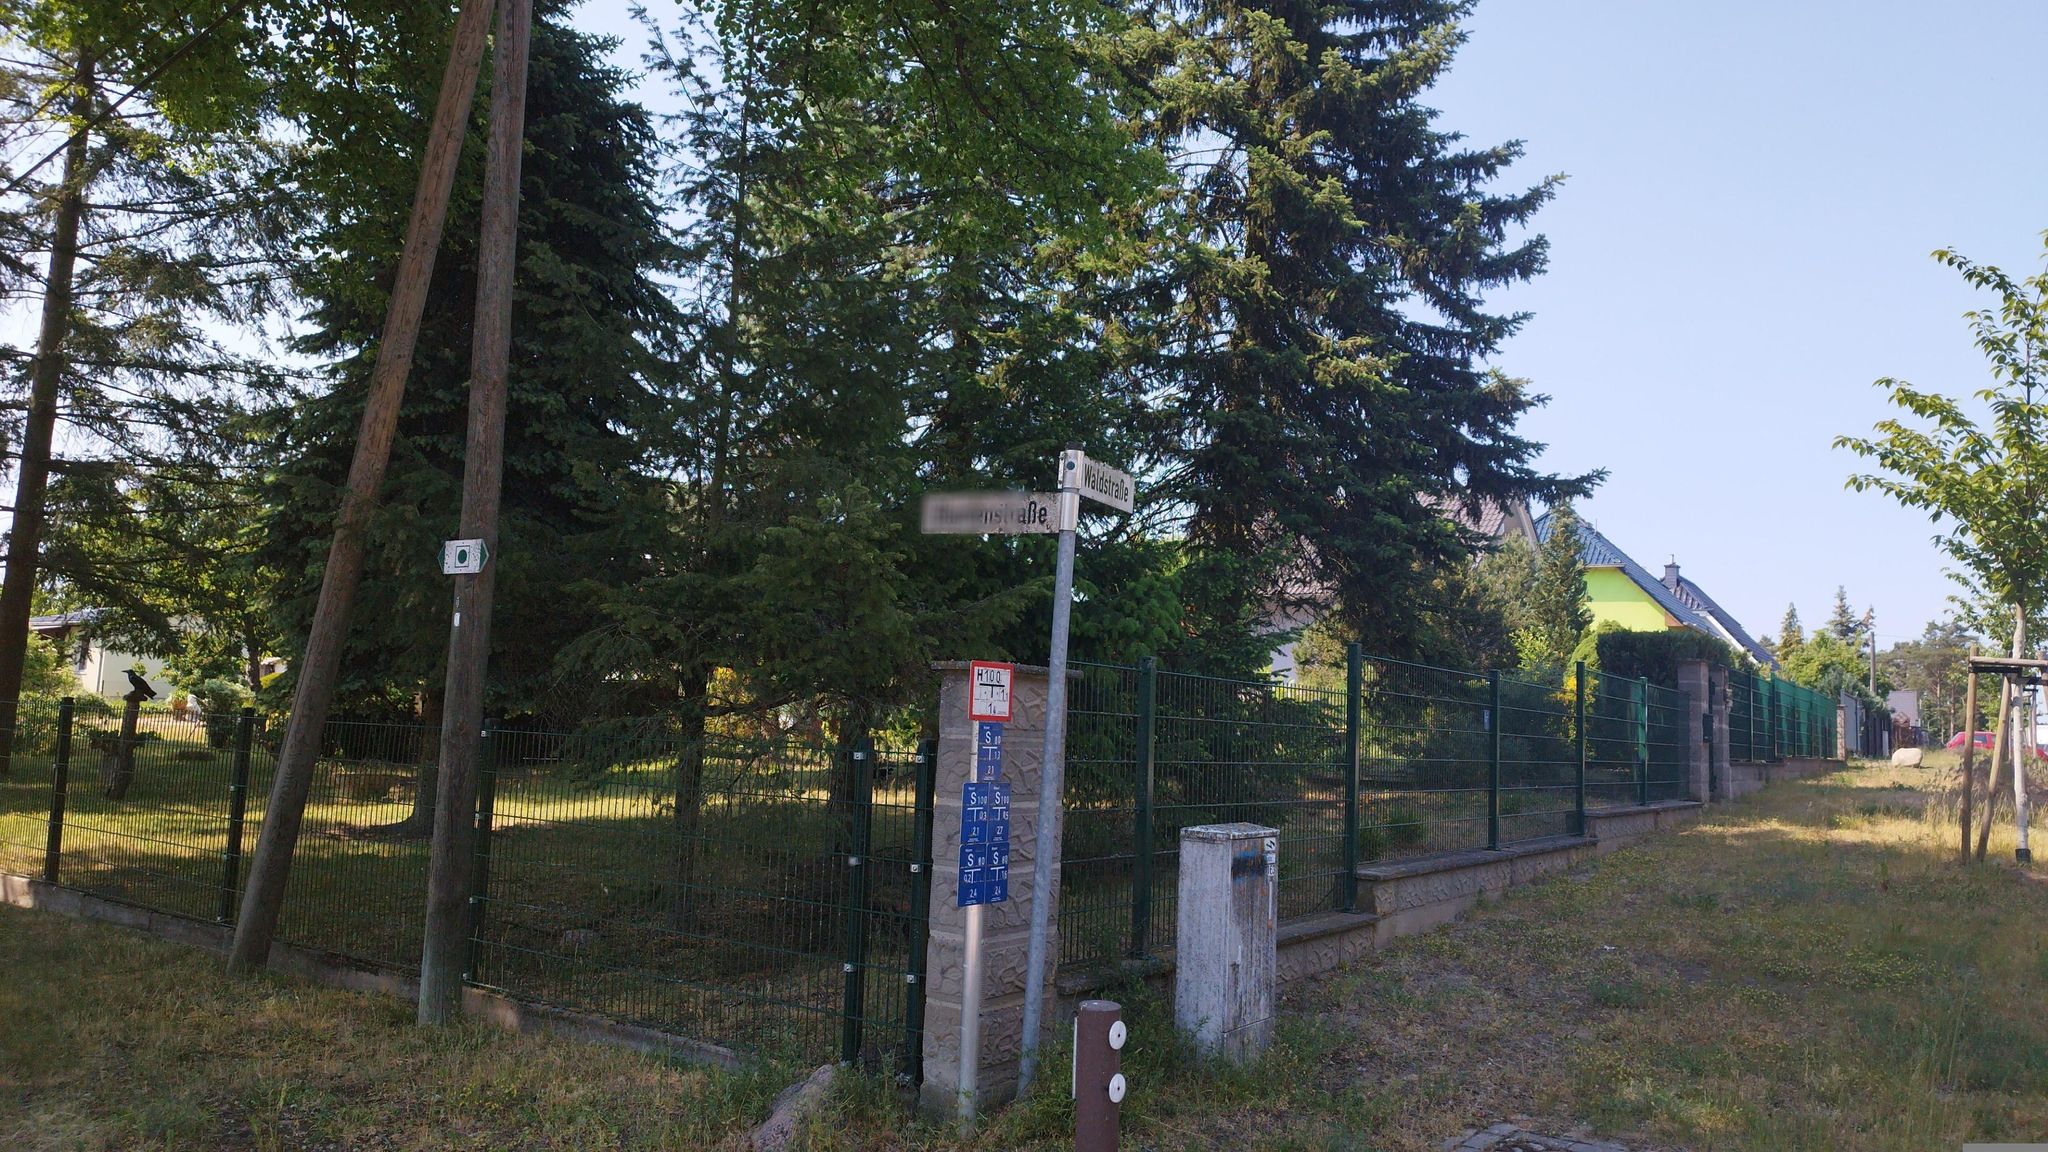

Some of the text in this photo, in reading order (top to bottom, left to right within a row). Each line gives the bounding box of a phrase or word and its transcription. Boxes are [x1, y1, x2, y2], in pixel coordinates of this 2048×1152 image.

[1084, 463, 1129, 502] Waldstraße
[985, 731, 991, 744] S
[970, 792, 977, 804] S
[995, 792, 1001, 804] S
[967, 853, 974, 866] S
[993, 851, 999, 864] S
